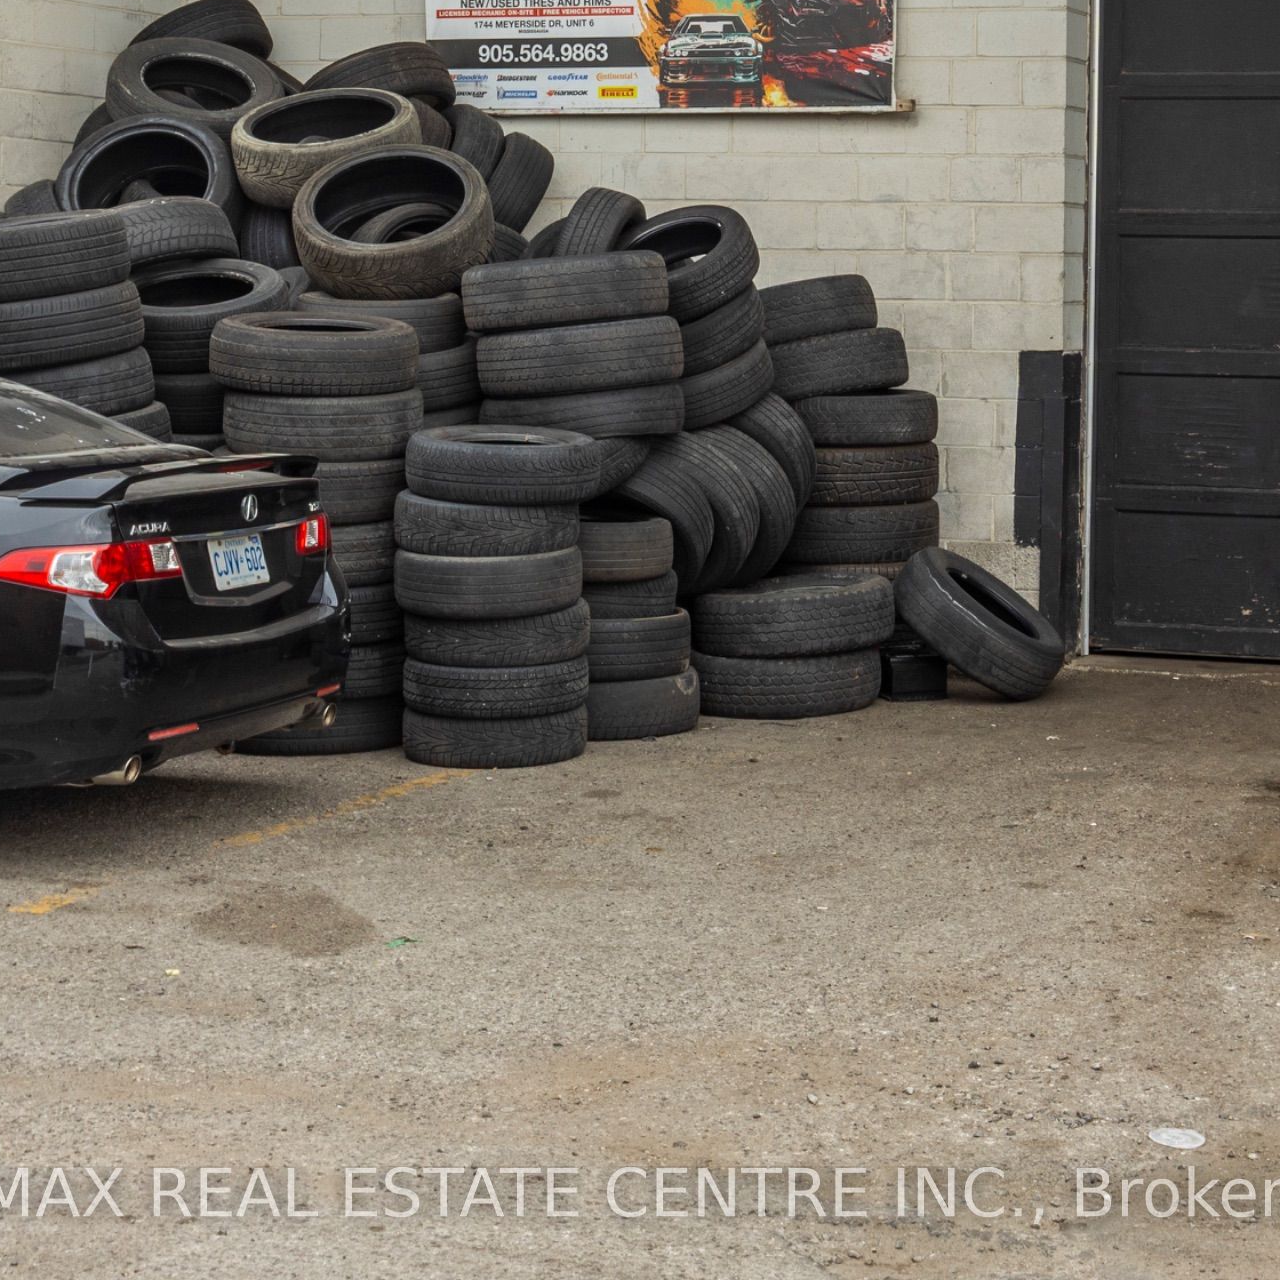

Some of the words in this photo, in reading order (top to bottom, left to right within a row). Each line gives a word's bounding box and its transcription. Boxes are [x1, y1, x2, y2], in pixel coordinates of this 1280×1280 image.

[438, 9, 470, 17] LICENSED
[495, 20, 546, 28] MEYERSIDE
[566, 19, 587, 27] UNIT
[589, 19, 594, 27] 6
[478, 43, 609, 63] 905.564.9863
[130, 521, 171, 535] ACURA
